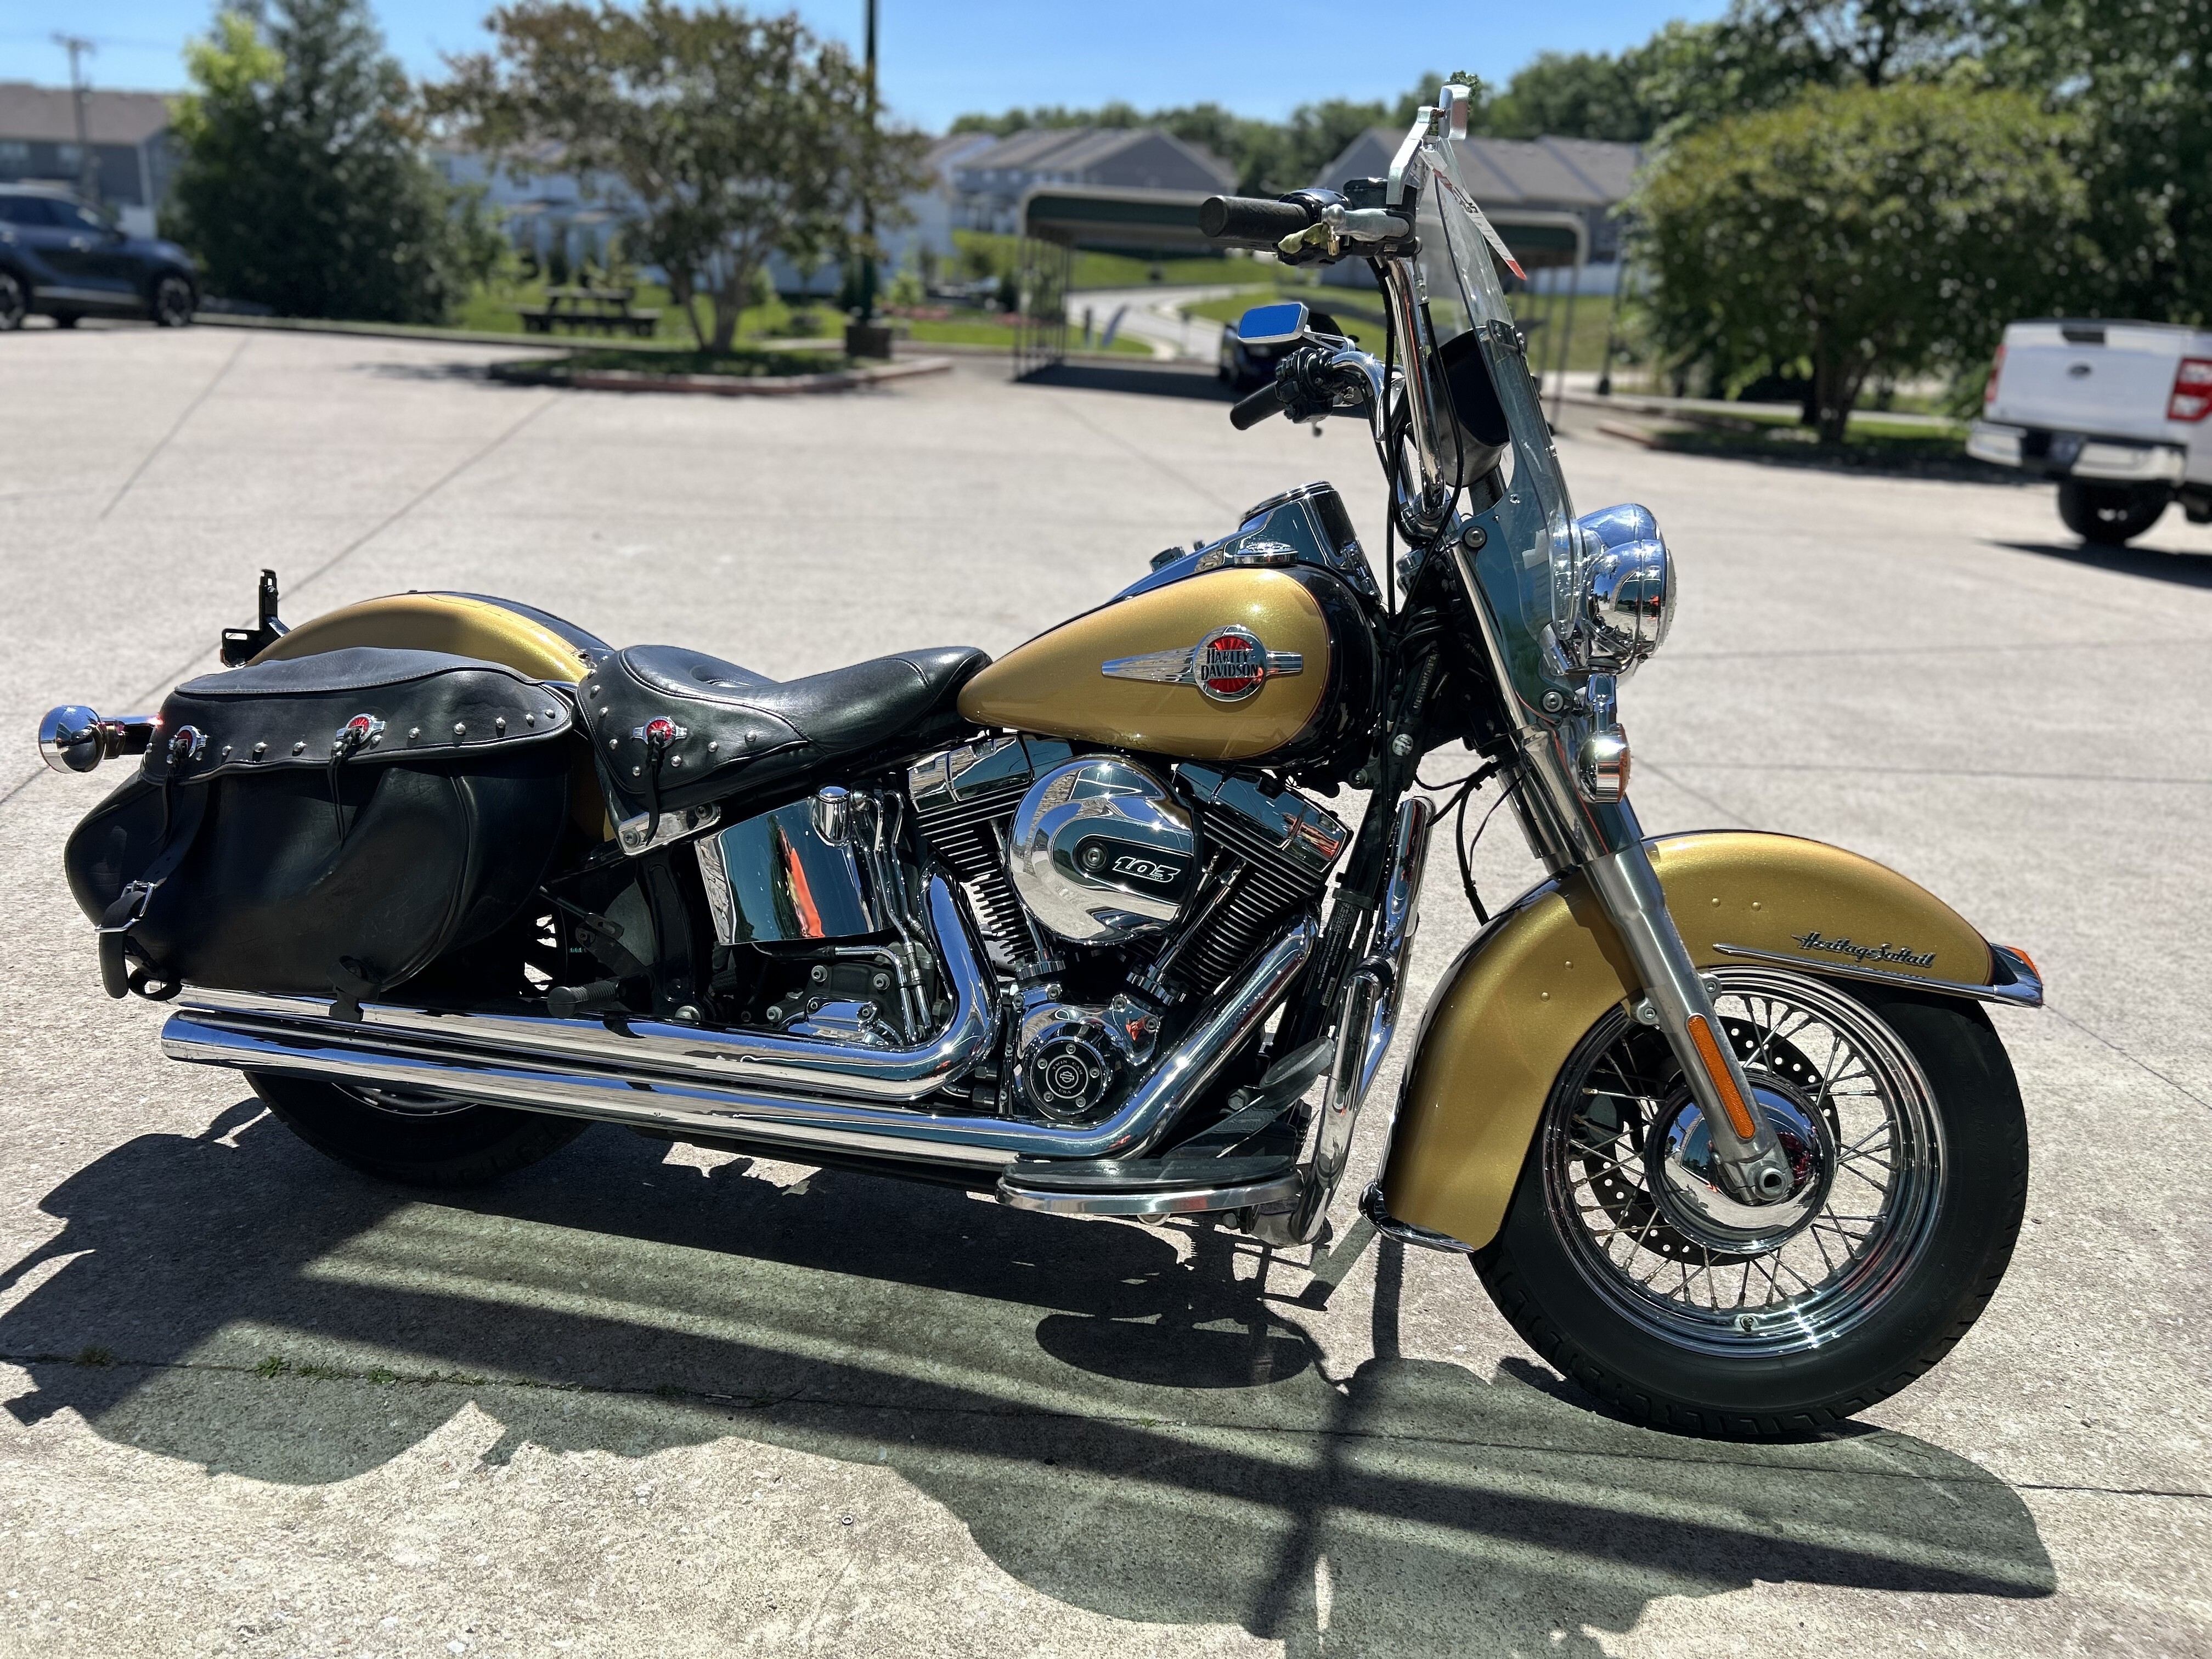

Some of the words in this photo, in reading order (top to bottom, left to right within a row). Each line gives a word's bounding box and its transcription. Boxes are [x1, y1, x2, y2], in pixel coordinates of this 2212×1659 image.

[1201, 664, 1258, 681] DAVIDSON
[1112, 856, 1181, 883] 103
[1052, 1060, 1068, 1070] TWIN
